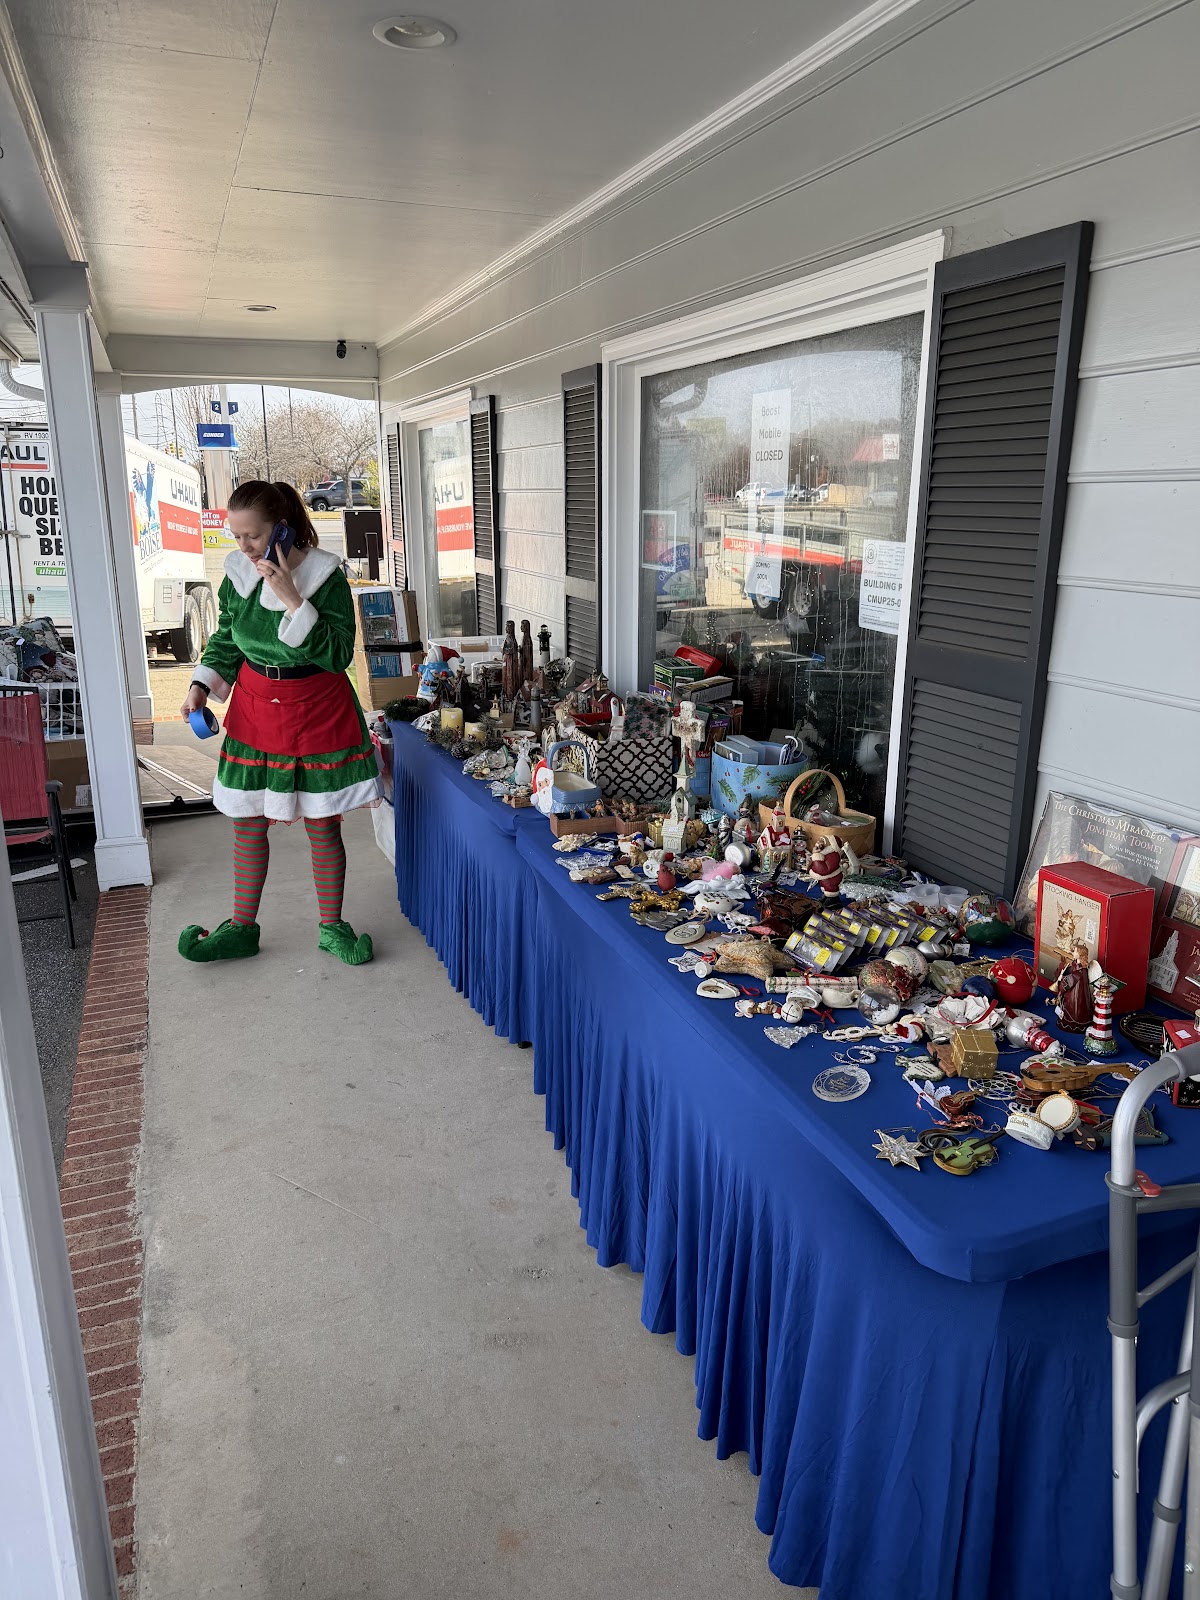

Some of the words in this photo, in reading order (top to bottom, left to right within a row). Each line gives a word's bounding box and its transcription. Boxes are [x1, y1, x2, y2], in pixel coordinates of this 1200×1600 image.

[758, 427, 782, 440] Mobile
[755, 449, 784, 461] CLOSED
[170, 478, 198, 507] U-HAUL
[863, 578, 897, 592] BUILDING
[1054, 801, 1067, 812] THE
[1069, 804, 1116, 828] CHRISTMAS
[1115, 819, 1157, 841] MIRACLE
[1156, 833, 1168, 844] OF
[1085, 821, 1129, 844] JONATHAN
[1129, 835, 1165, 856] TOOMEY
[1043, 882, 1073, 901] STOCKING
[1074, 892, 1100, 912] HANGER
